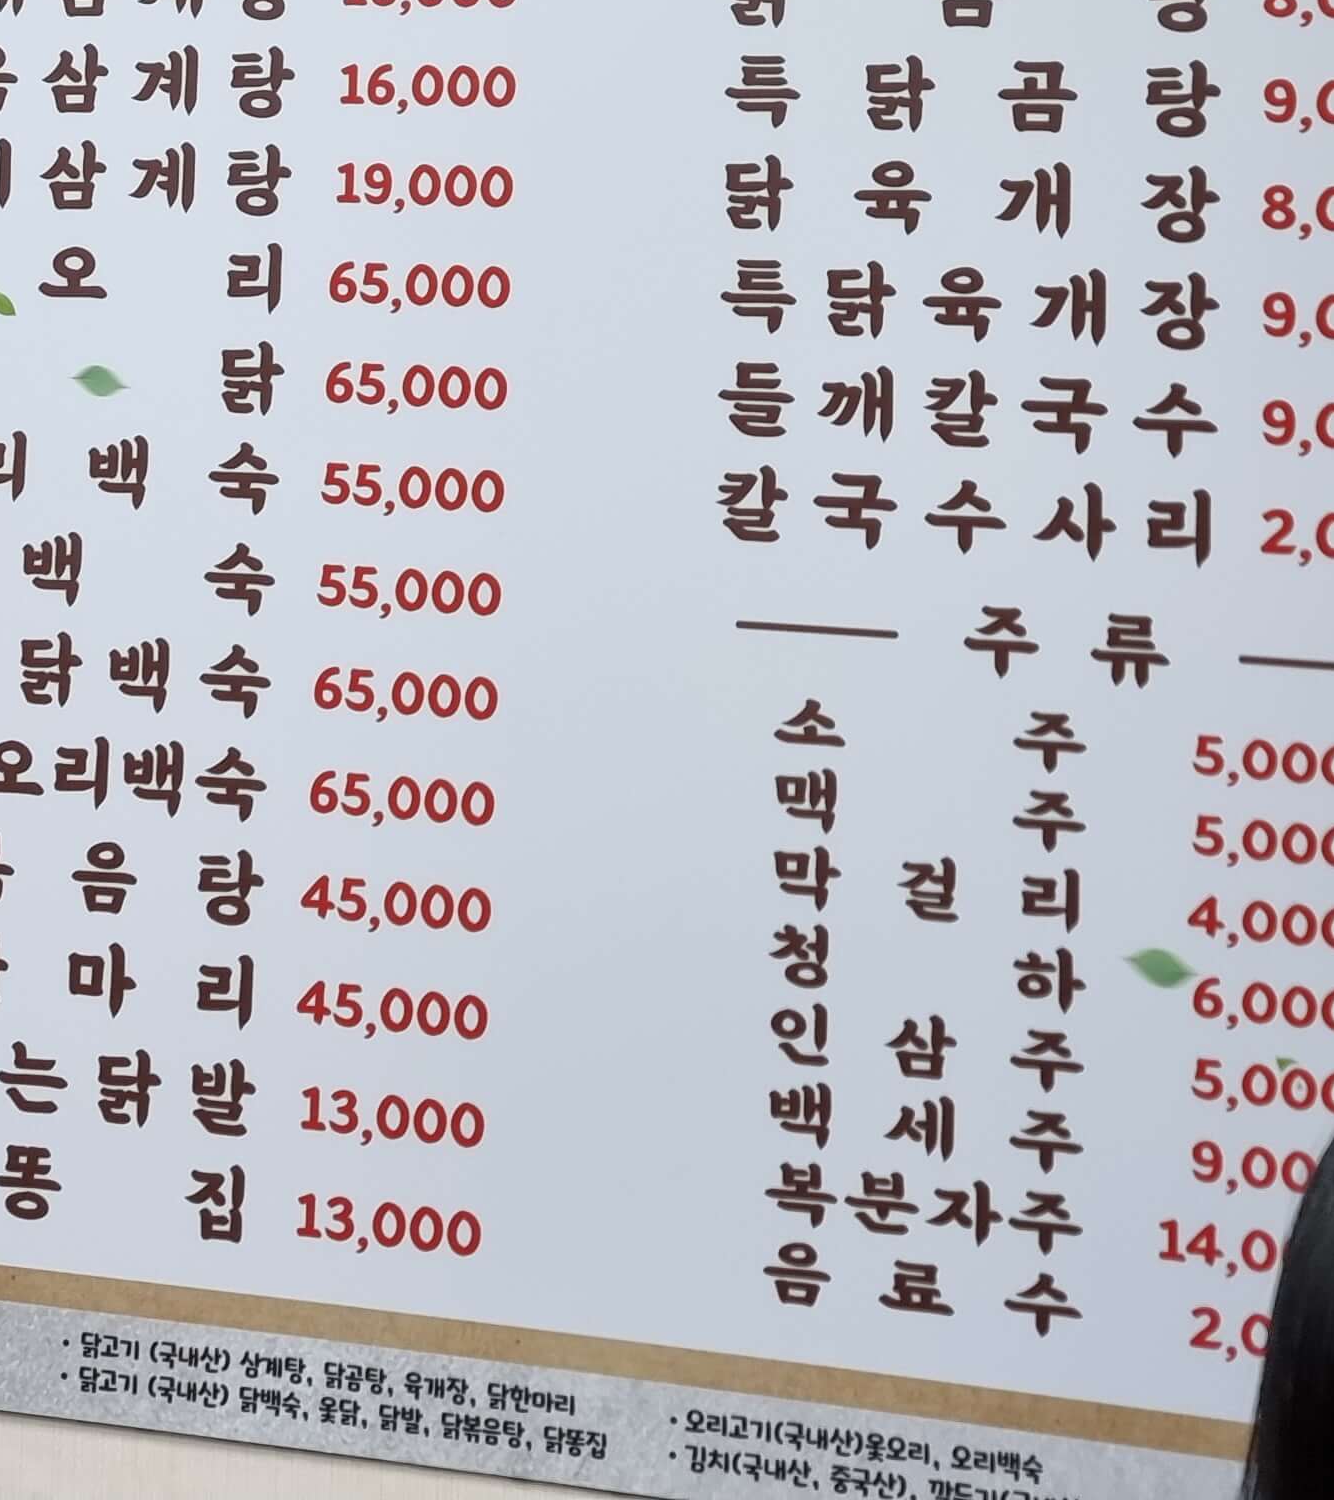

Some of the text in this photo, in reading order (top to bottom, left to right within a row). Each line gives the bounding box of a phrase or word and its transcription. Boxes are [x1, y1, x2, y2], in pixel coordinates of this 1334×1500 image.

[341, 62, 518, 110] 16,000
[336, 162, 515, 210] 19,000
[329, 260, 513, 310] 65,000
[324, 361, 509, 412] 65,000
[322, 460, 506, 514] 55,000
[318, 562, 503, 617] 55,000
[313, 665, 499, 722] 65,000
[309, 770, 497, 827] 65,000
[300, 874, 493, 933] 45,000
[297, 979, 490, 1040] 45,000
[301, 1086, 487, 1148] 13,000
[1191, 1138, 1319, 1196] 9,00
[297, 1192, 483, 1257] 13,000
[80, 1331, 576, 1417] 닭고기 (국내산) 삼계탕, 닭곰탕, 육개장, 닭한마리
[78, 1365, 138, 1396] 닭고기
[147, 1375, 230, 1408] (국내산)
[238, 1386, 309, 1422] 닭백숙,
[378, 1403, 430, 1438] 닭발,
[440, 1411, 533, 1451] 닭볶음탕,
[543, 1425, 608, 1461] 닭똥집
[950, 1444, 1044, 1486] 오리백숙
